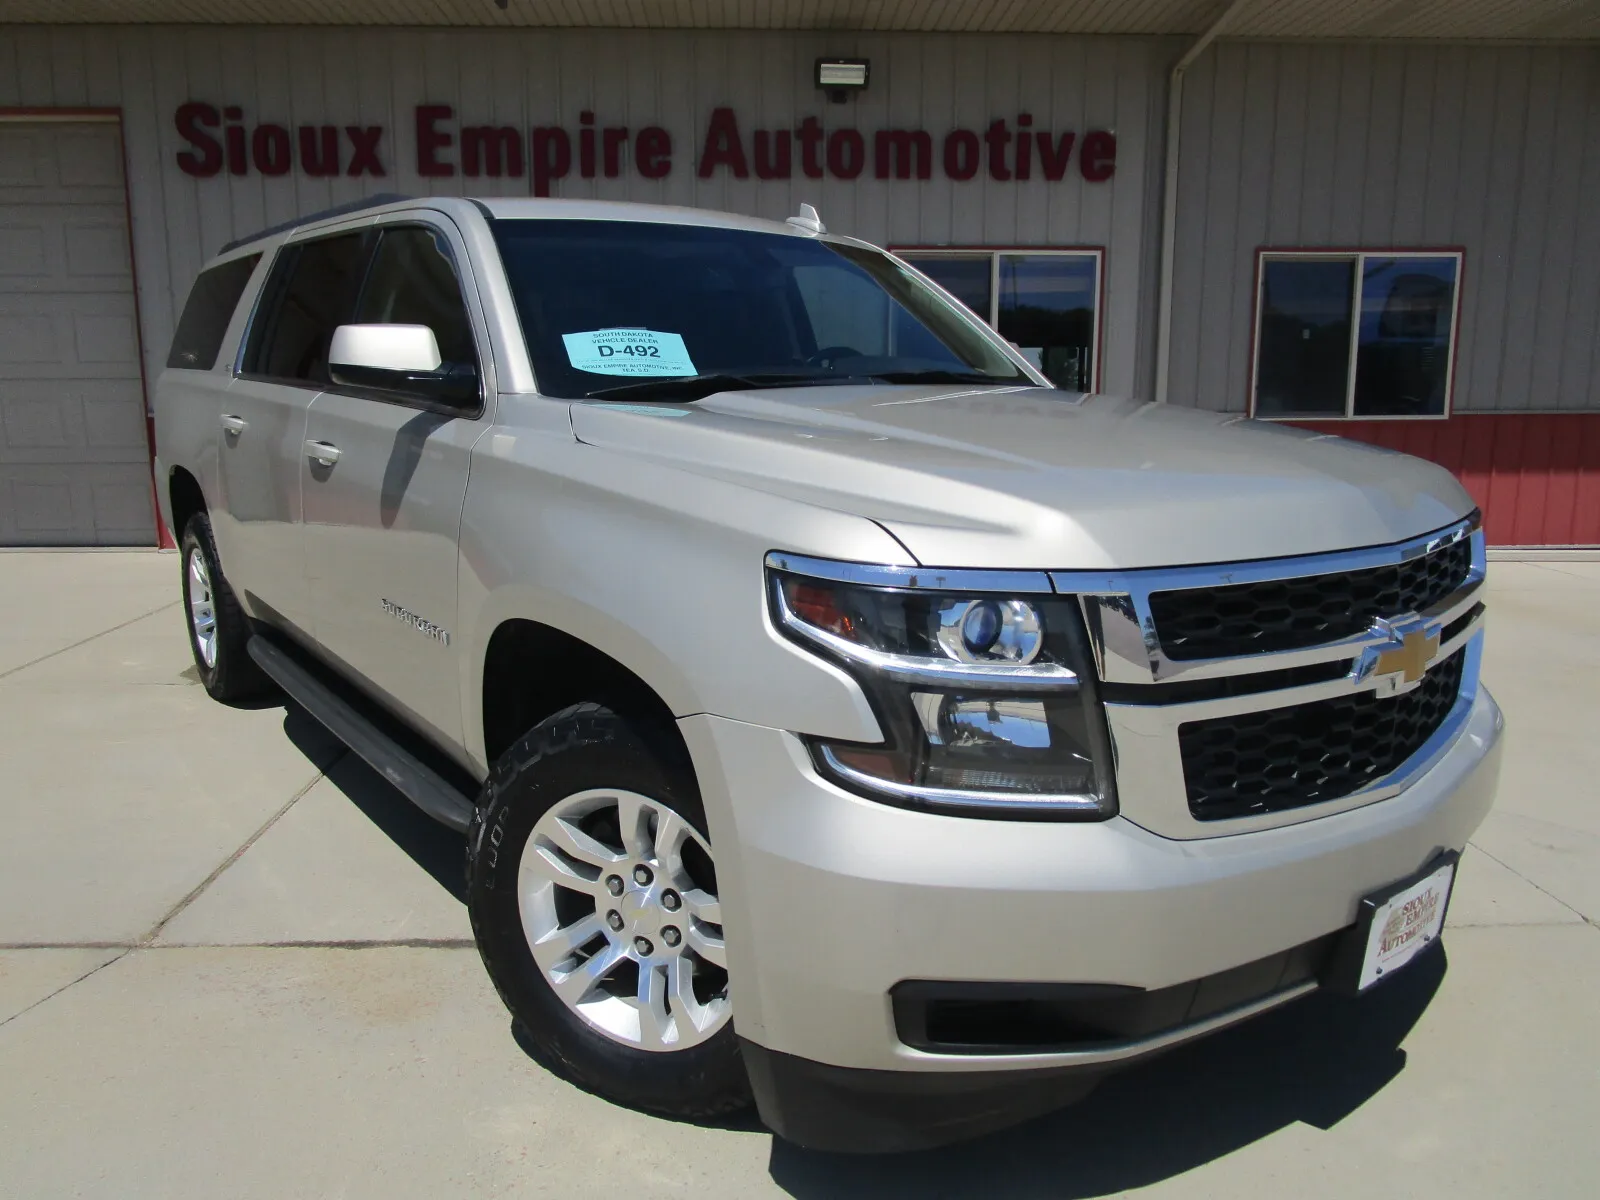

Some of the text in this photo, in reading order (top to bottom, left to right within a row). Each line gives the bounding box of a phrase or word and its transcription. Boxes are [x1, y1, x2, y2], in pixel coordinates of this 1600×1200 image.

[174, 102, 1117, 197] Sioux Empire Automotive
[597, 345, 661, 358] D-492
[381, 598, 449, 647] SUBURBAN
[1402, 887, 1432, 916] SIOUX
